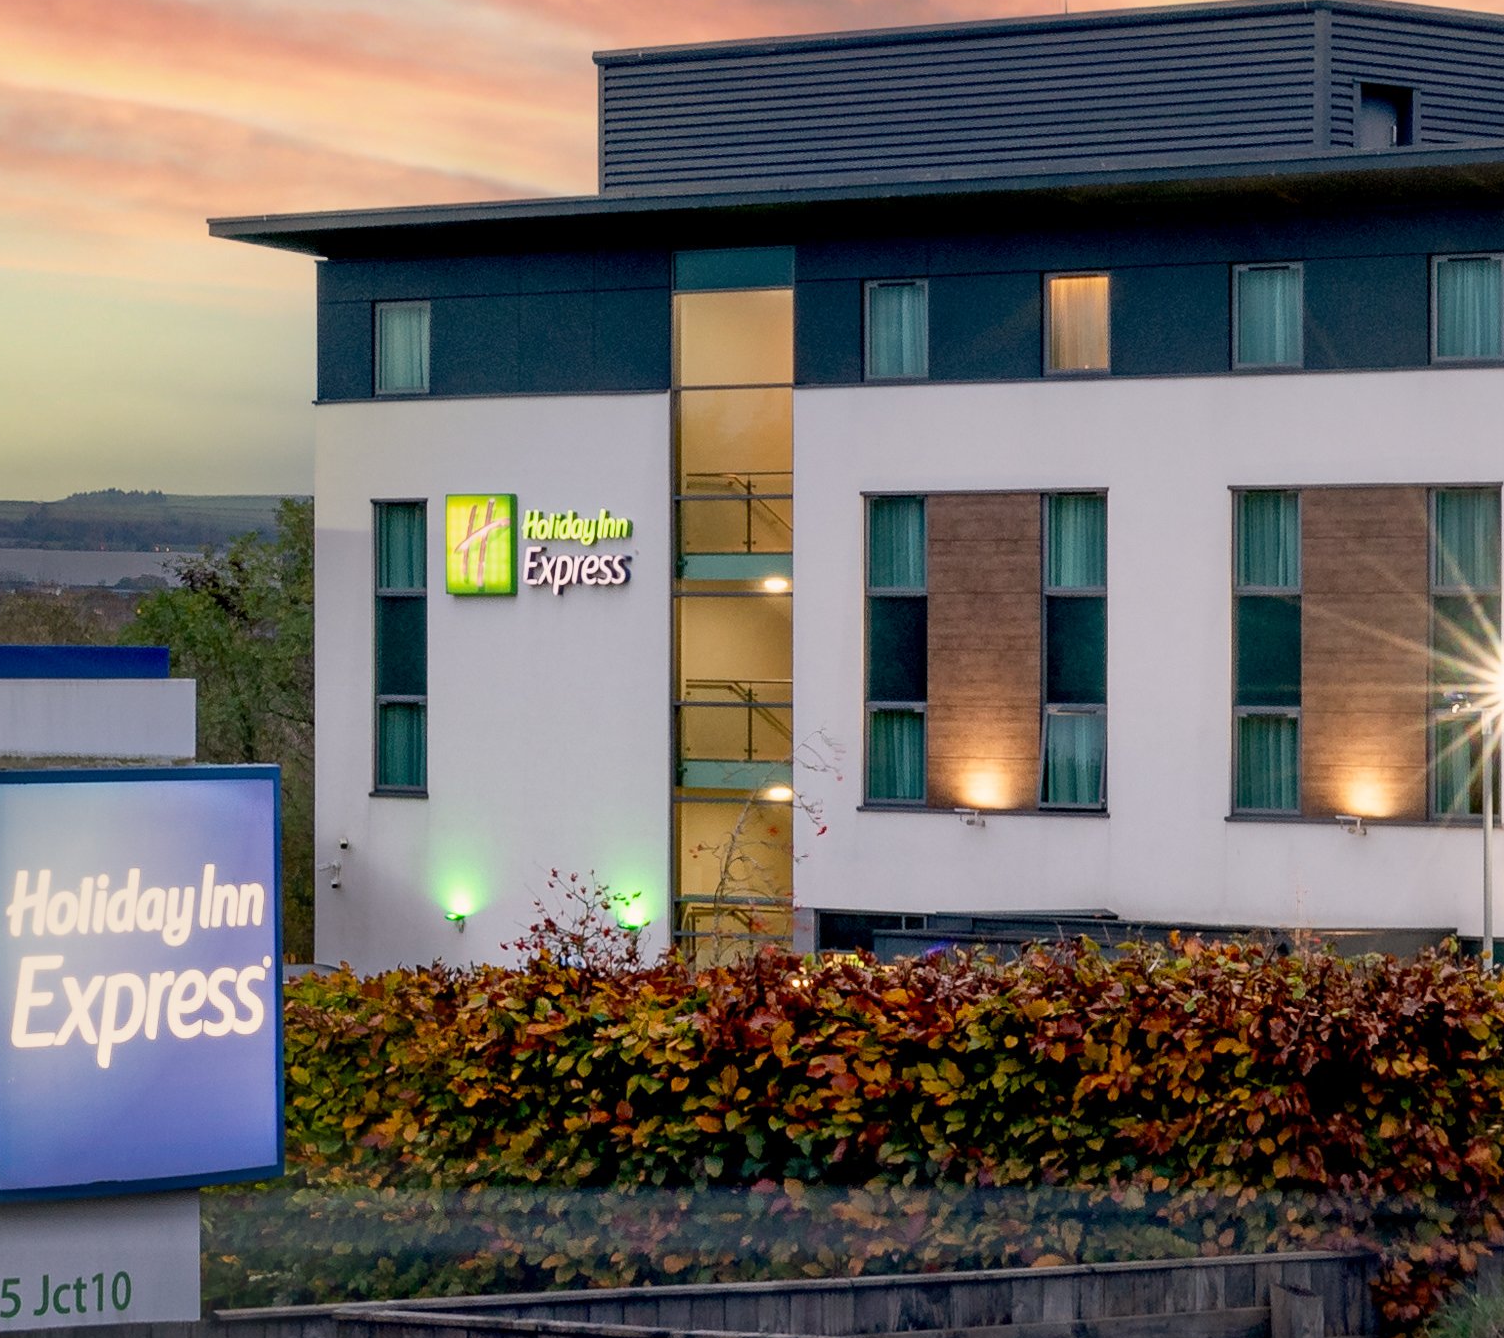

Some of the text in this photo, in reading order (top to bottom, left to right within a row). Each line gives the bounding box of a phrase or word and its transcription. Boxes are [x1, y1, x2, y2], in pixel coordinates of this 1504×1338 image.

[521, 508, 633, 546] Holiday Inn
[523, 546, 631, 595] Express
[6, 863, 264, 947] Holiday Inn
[11, 955, 266, 1069] Express
[33, 1270, 132, 1316] Jct10
